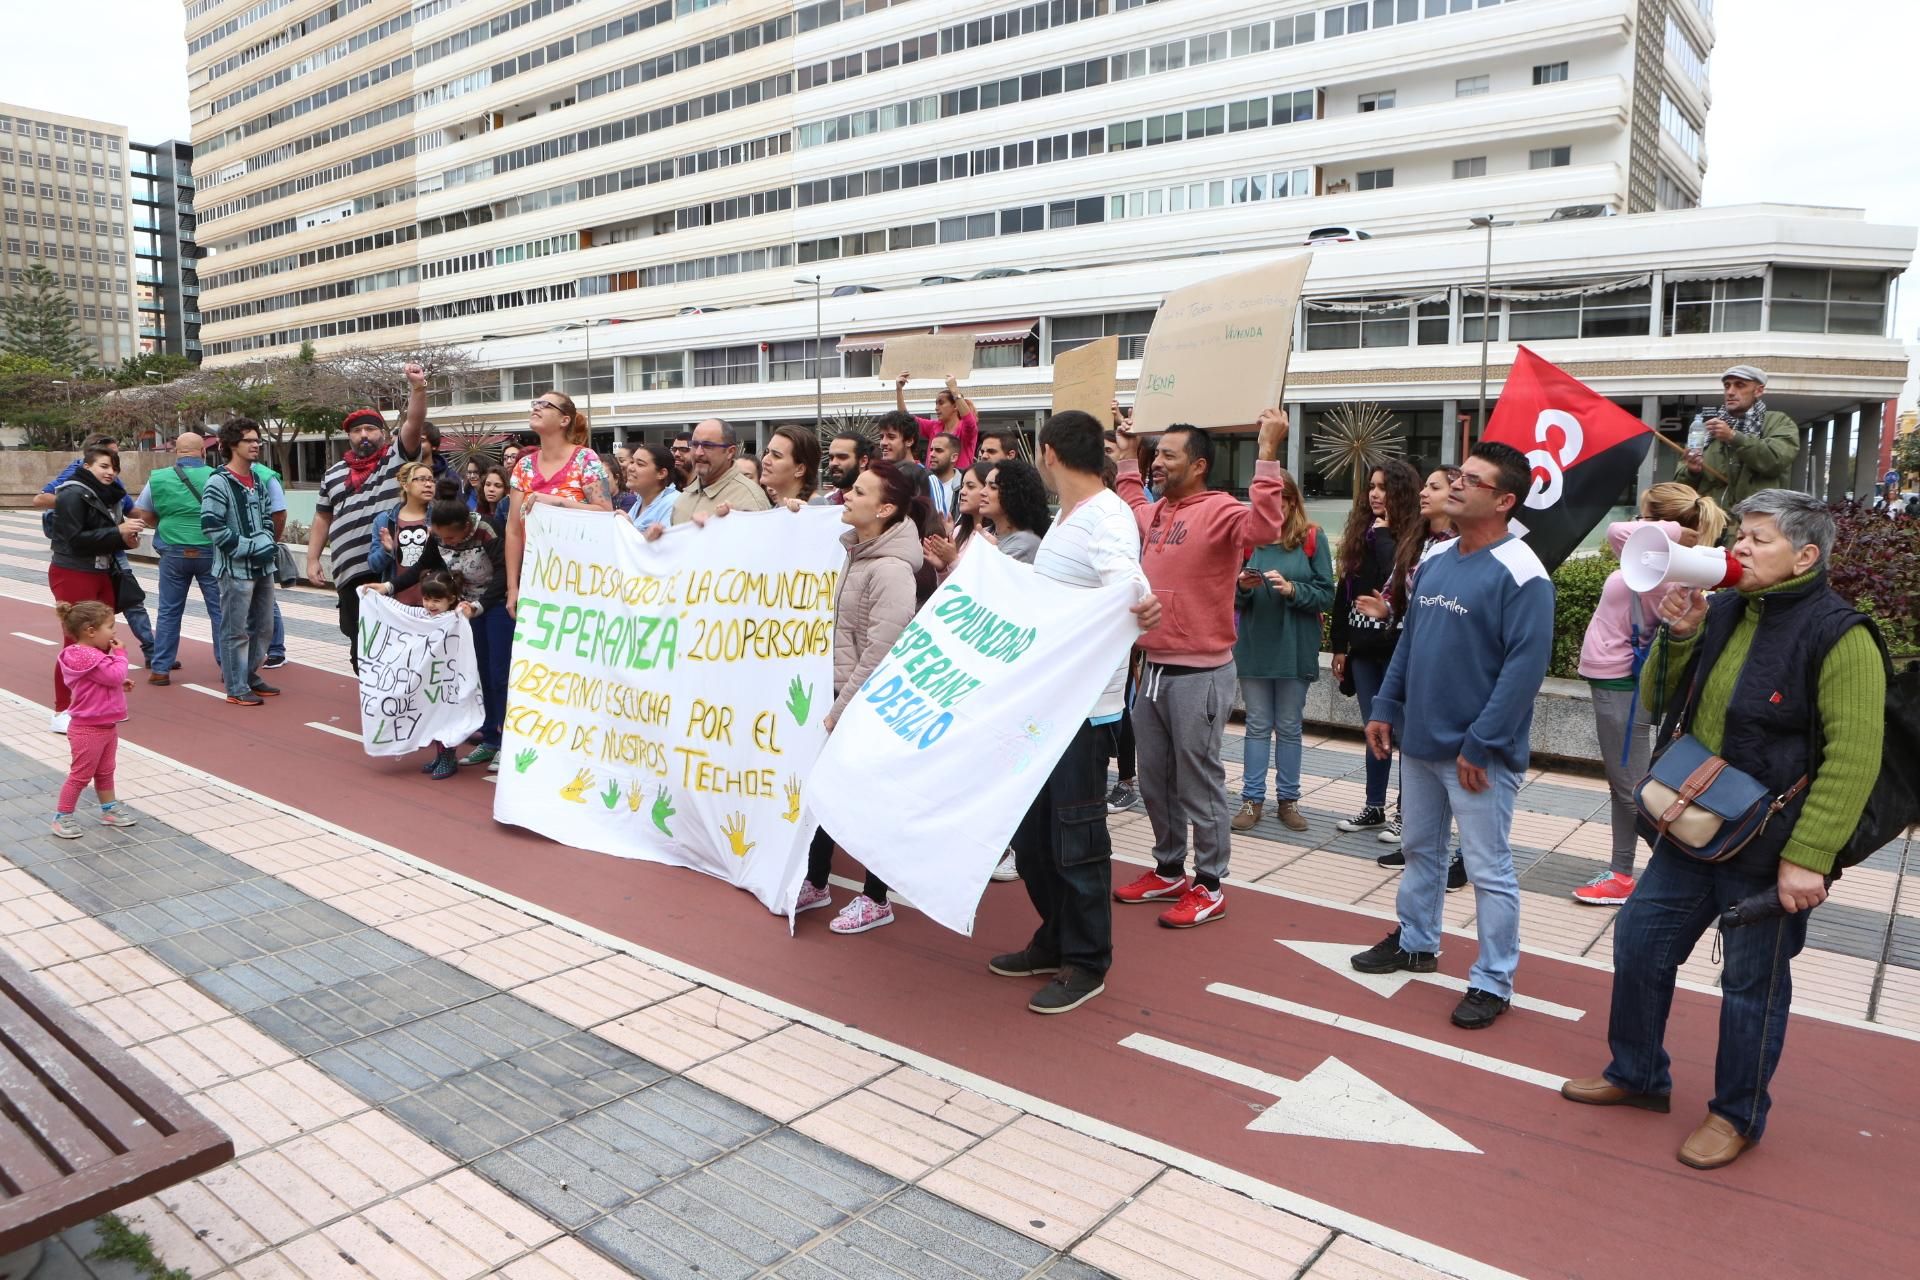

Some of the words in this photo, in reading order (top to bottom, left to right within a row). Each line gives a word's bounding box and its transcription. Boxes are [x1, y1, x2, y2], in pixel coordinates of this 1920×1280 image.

[1224, 323, 1263, 341] VIVIENDA
[531, 547, 562, 592] NO
[566, 560, 587, 596] AL
[685, 570, 712, 605] LA
[687, 618, 740, 662] 200
[381, 693, 418, 717] QUE
[605, 681, 671, 727] ESCUCHA
[686, 699, 734, 746] POR
[752, 710, 783, 755] EL
[372, 713, 422, 744] LEY
[570, 725, 599, 757] DE
[601, 727, 668, 777] NUESTROS
[672, 746, 777, 798] TECHOS
